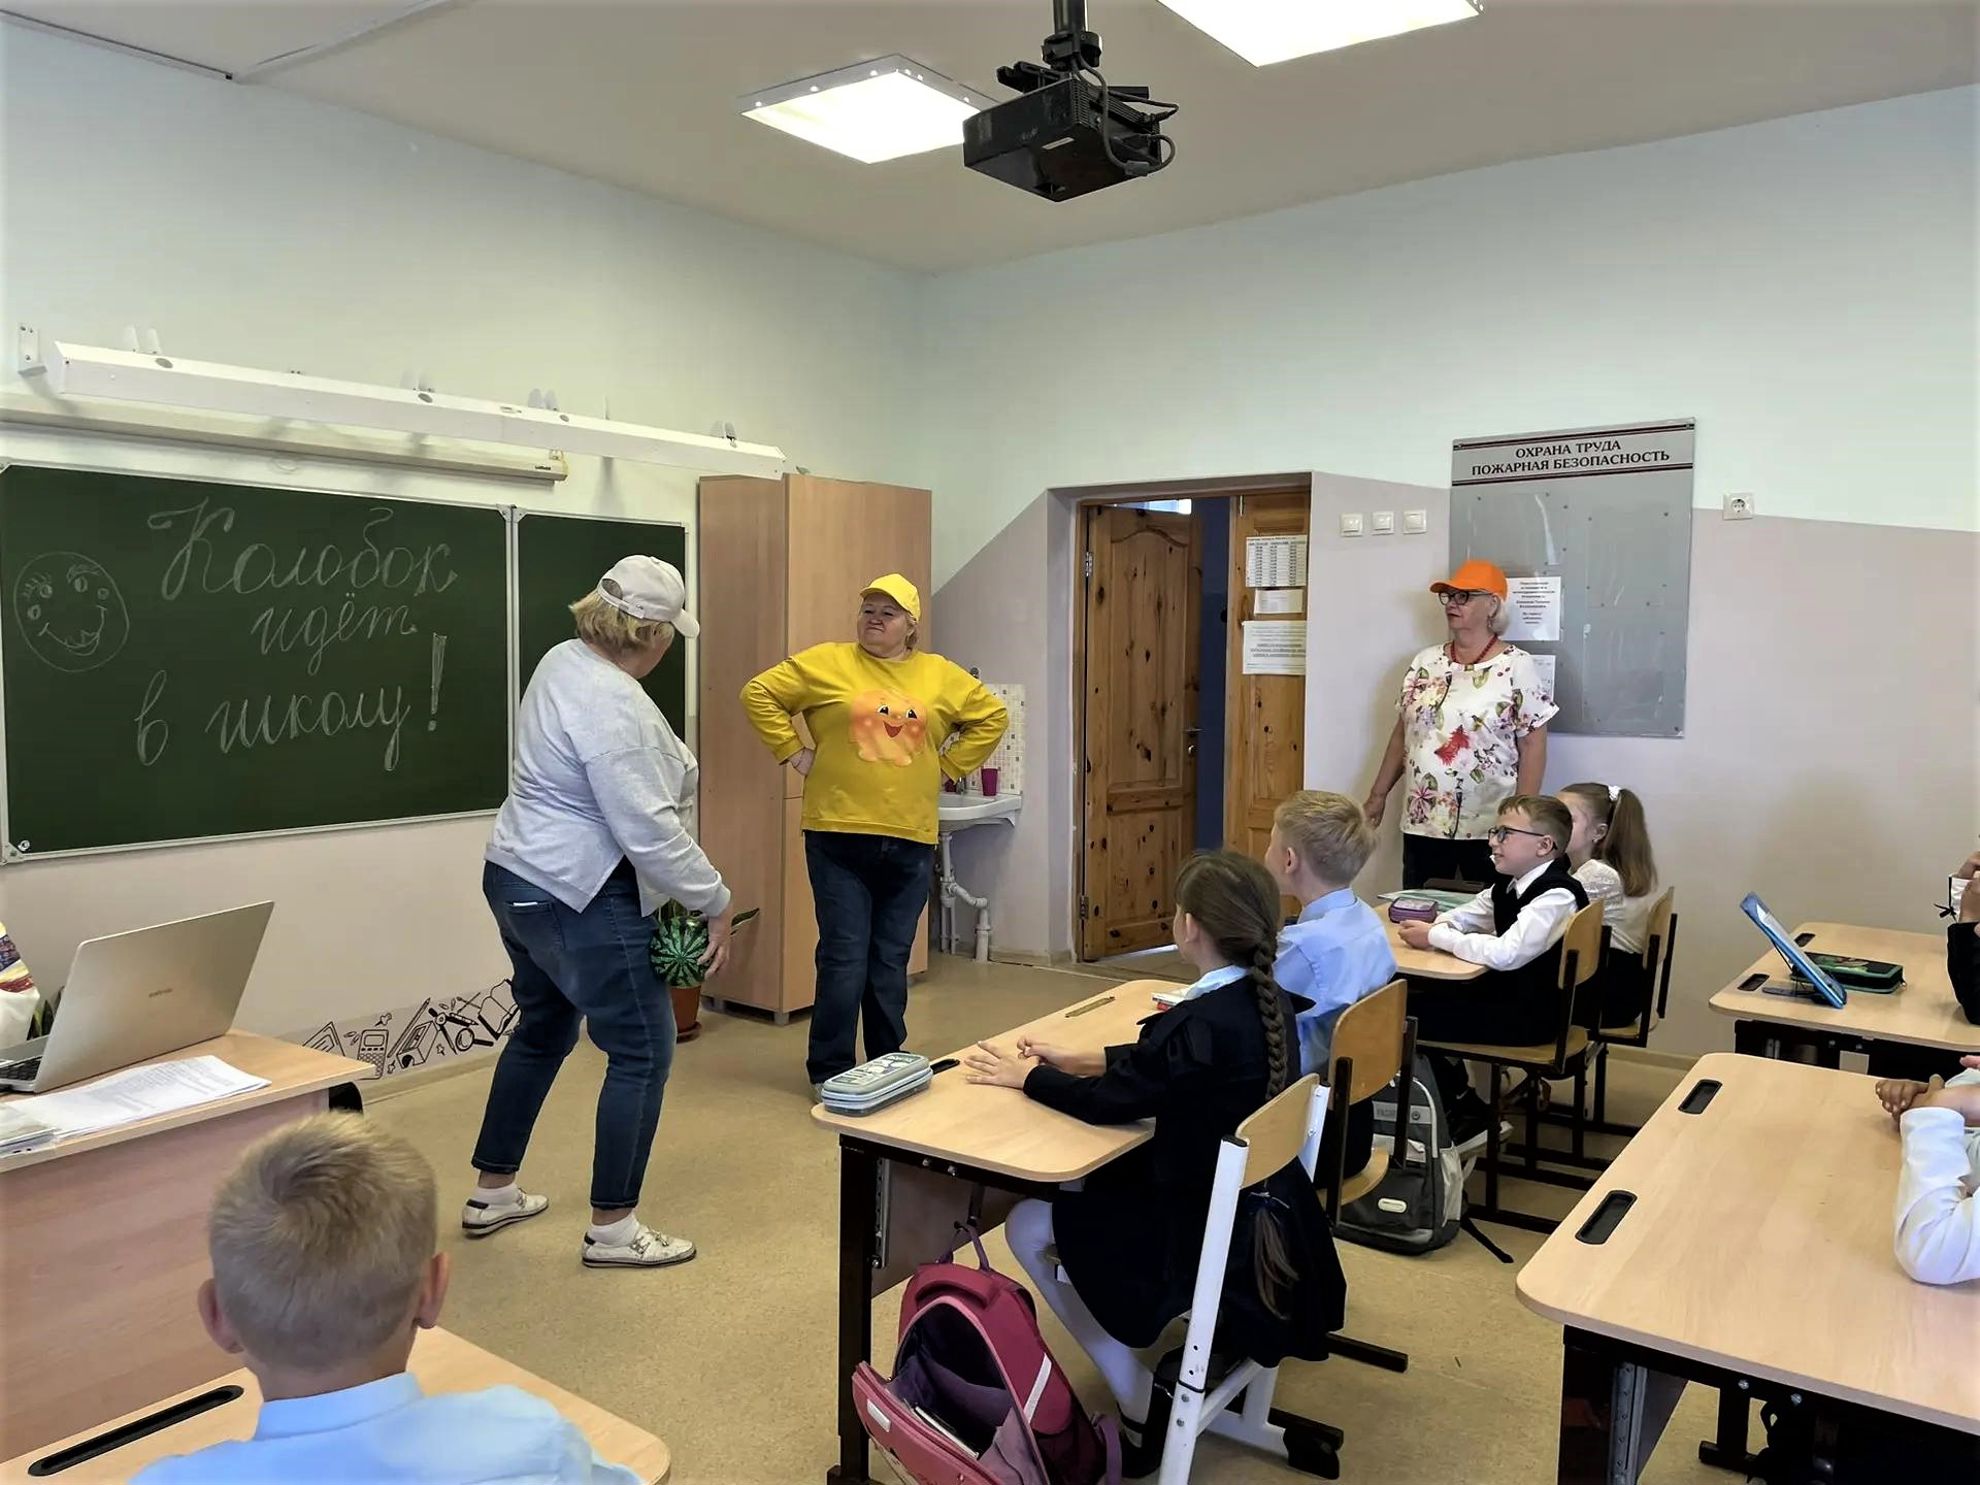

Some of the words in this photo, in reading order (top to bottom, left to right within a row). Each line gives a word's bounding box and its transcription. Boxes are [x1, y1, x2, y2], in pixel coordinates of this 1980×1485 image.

[1471, 459, 1550, 476] ПОЖАРНАЯ
[1553, 450, 1671, 470] БЕЗОПАСНОСТЬ
[1515, 444, 1572, 459] ОХРАНА
[1576, 440, 1622, 454] ТРУДА
[147, 496, 458, 601] Колобок
[250, 591, 418, 676] идёт
[134, 669, 169, 767] в
